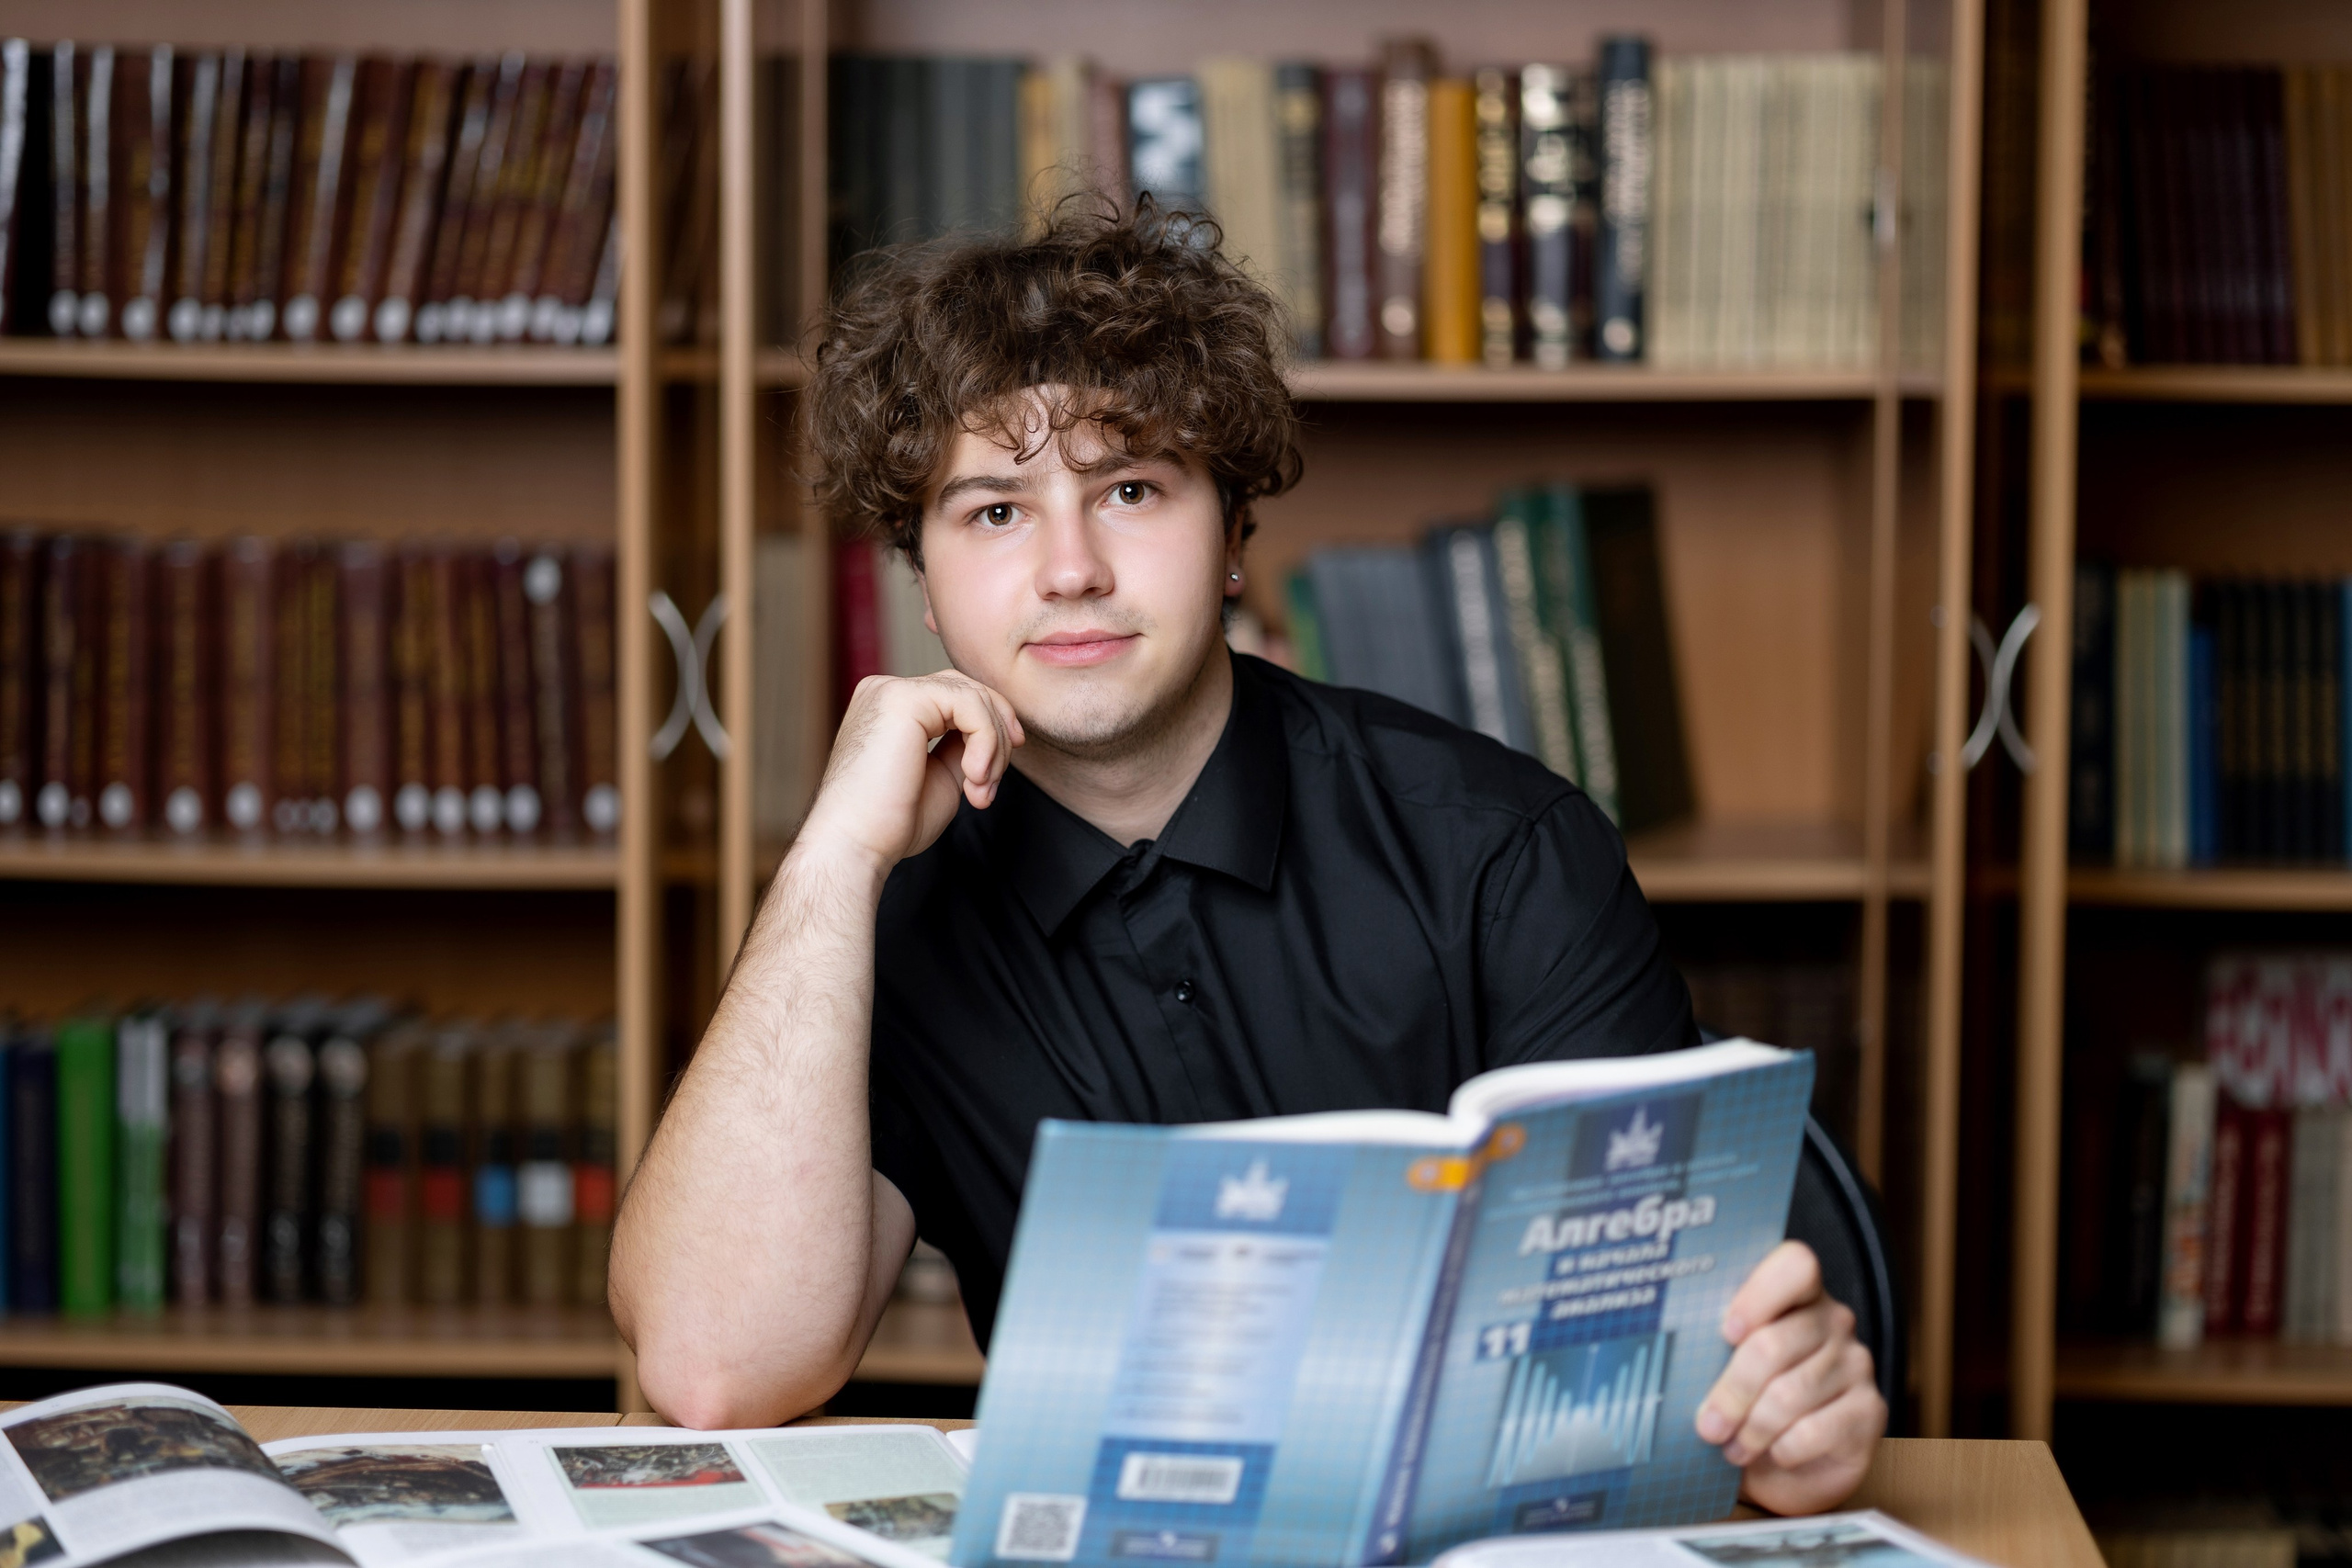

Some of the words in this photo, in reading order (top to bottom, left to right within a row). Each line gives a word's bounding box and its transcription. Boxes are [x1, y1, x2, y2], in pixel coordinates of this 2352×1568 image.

[1518, 1194, 1716, 1257] Алгебра
[1577, 1241, 1670, 1268] начала
[1550, 1286, 1657, 1320] анализа
[1482, 1322, 1532, 1359] 11
